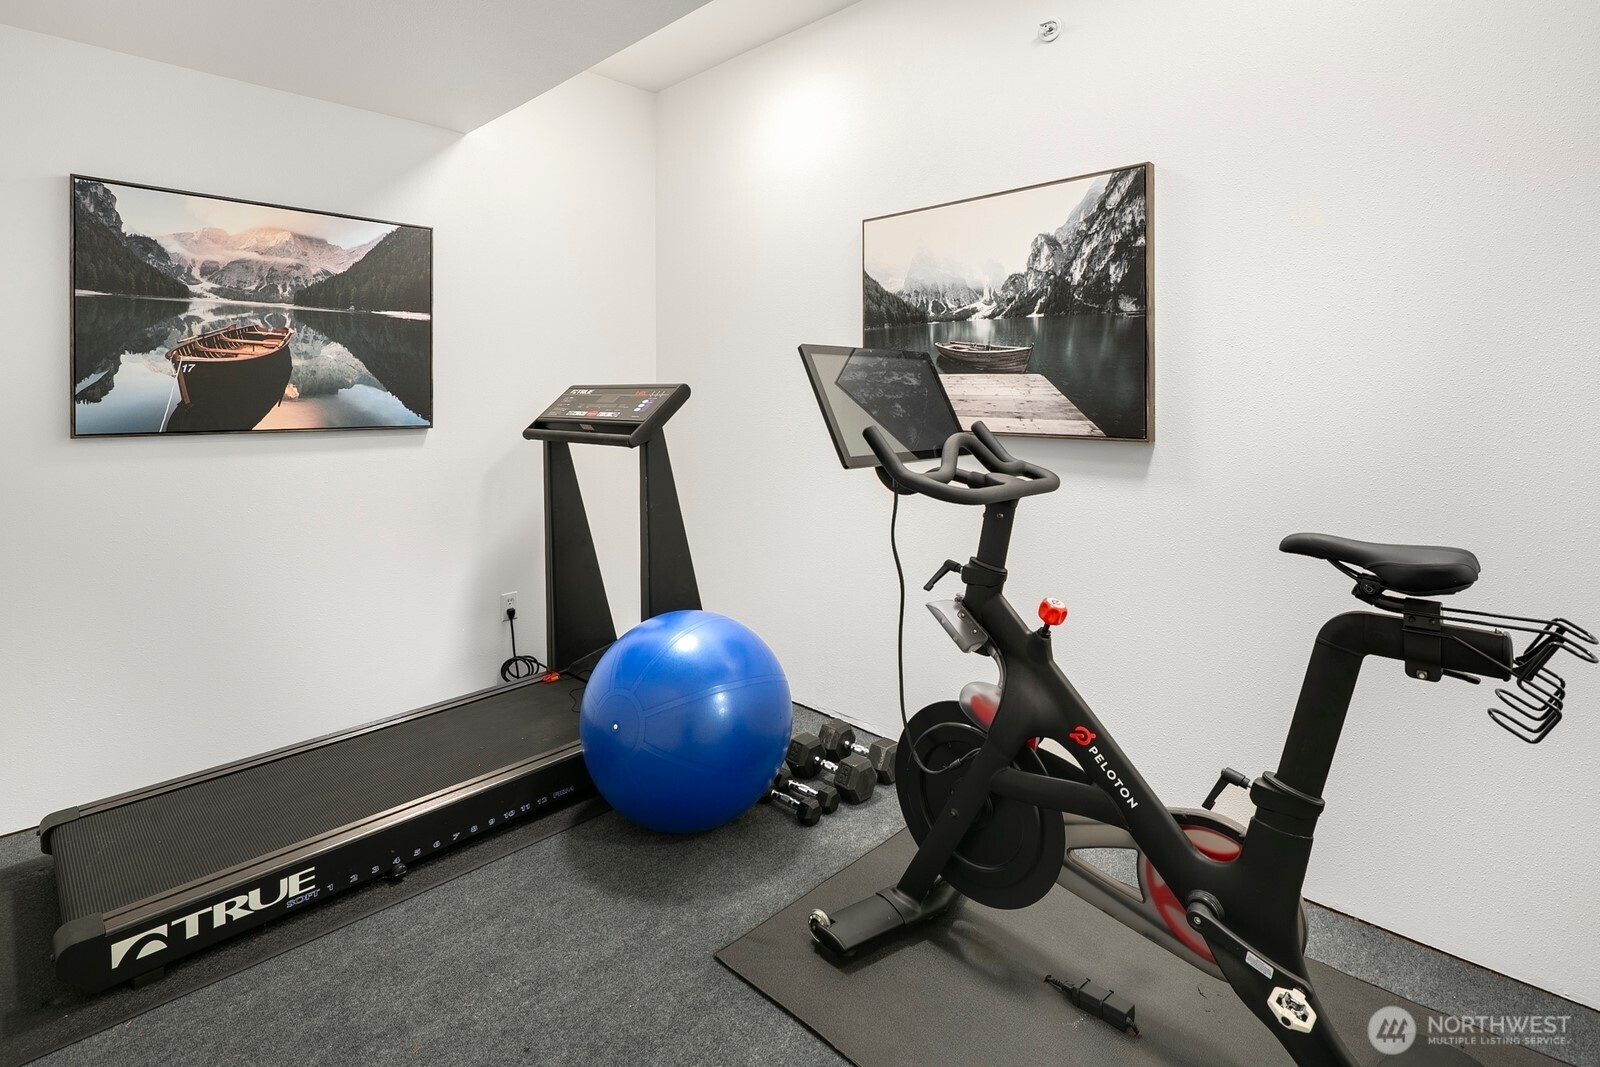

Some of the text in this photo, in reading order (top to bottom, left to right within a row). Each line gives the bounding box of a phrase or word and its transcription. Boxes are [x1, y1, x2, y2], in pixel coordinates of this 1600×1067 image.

[182, 363, 196, 373] 17
[1088, 745, 1138, 809] PELOTON
[327, 883, 334, 892] 1
[349, 873, 359, 883] 2
[371, 865, 380, 874] 3
[432, 840, 441, 849] 6
[452, 831, 461, 841] 7
[503, 809, 516, 819] 10
[520, 803, 531, 812] 11
[171, 866, 316, 940] TRUE
